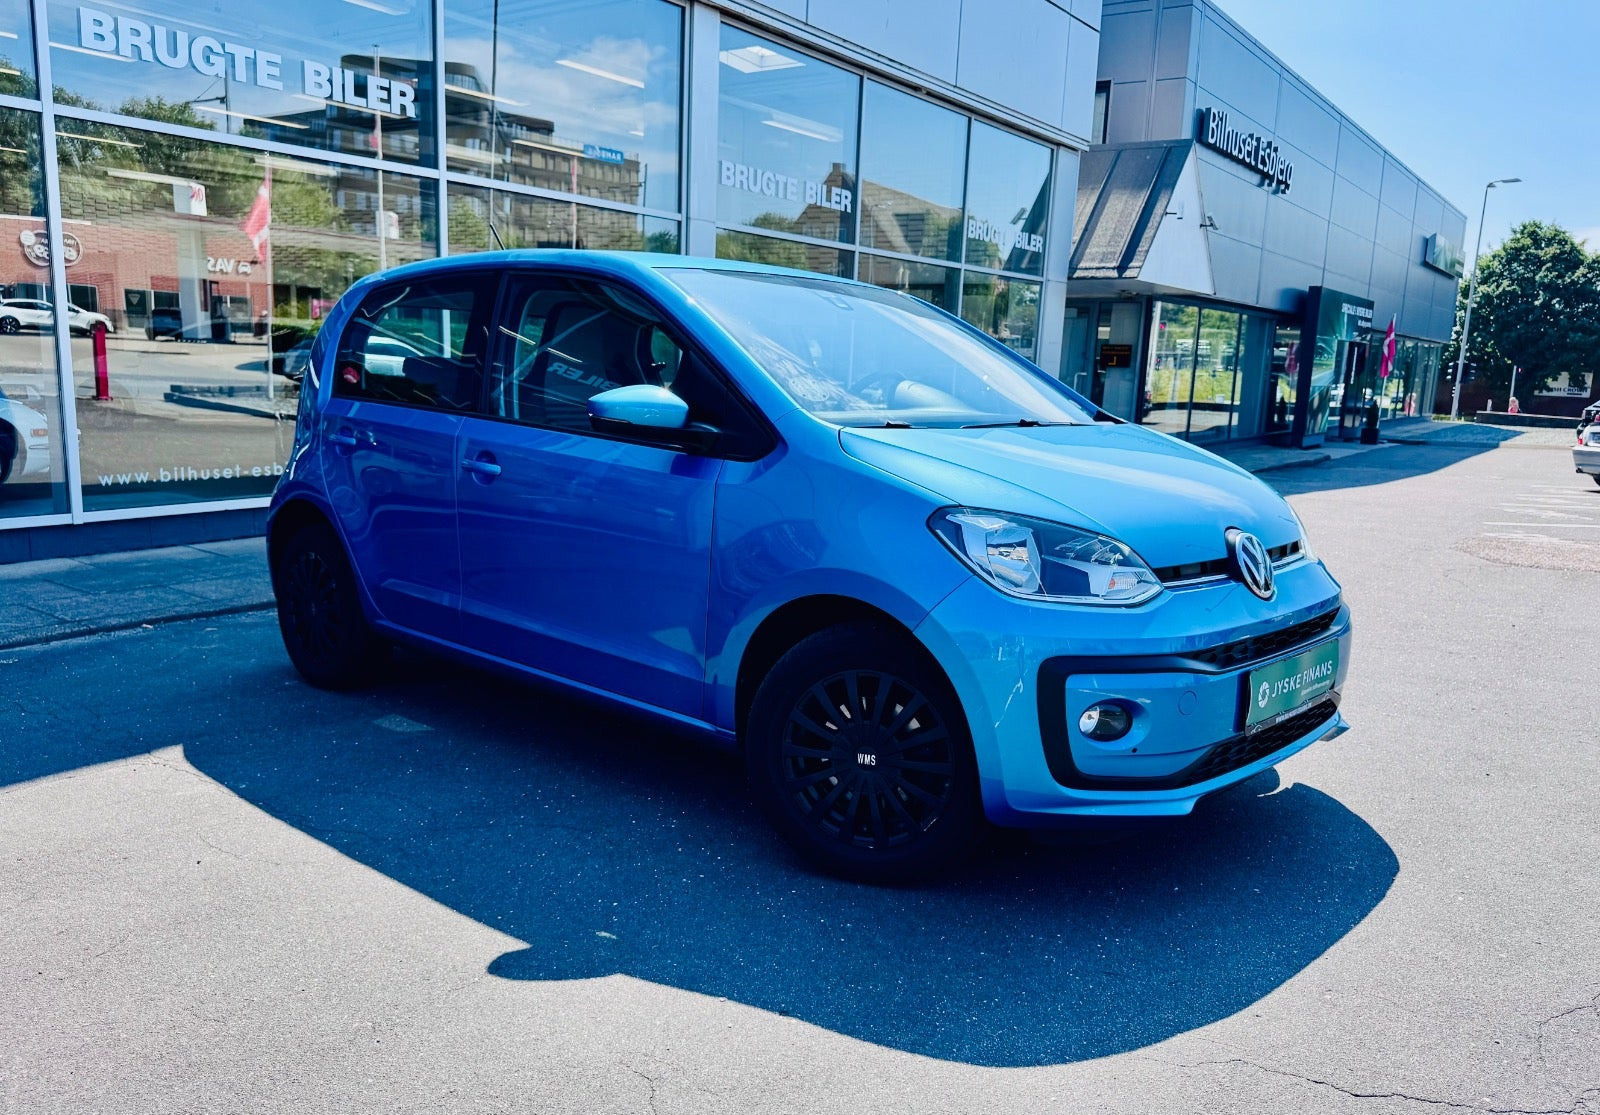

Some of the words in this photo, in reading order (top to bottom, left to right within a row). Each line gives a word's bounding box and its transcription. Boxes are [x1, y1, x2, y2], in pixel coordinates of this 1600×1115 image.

[79, 7, 283, 91] BRUGTE
[303, 60, 417, 118] BILER
[1208, 107, 1257, 166] Bilhuset
[1258, 137, 1294, 194] Esbjerg
[721, 160, 799, 201] BRUGTE
[806, 179, 853, 214] BILER
[1015, 232, 1044, 253] BILER
[1272, 673, 1302, 698] JYSKE
[1302, 660, 1333, 686] FINANS
[857, 752, 876, 766] WMS
